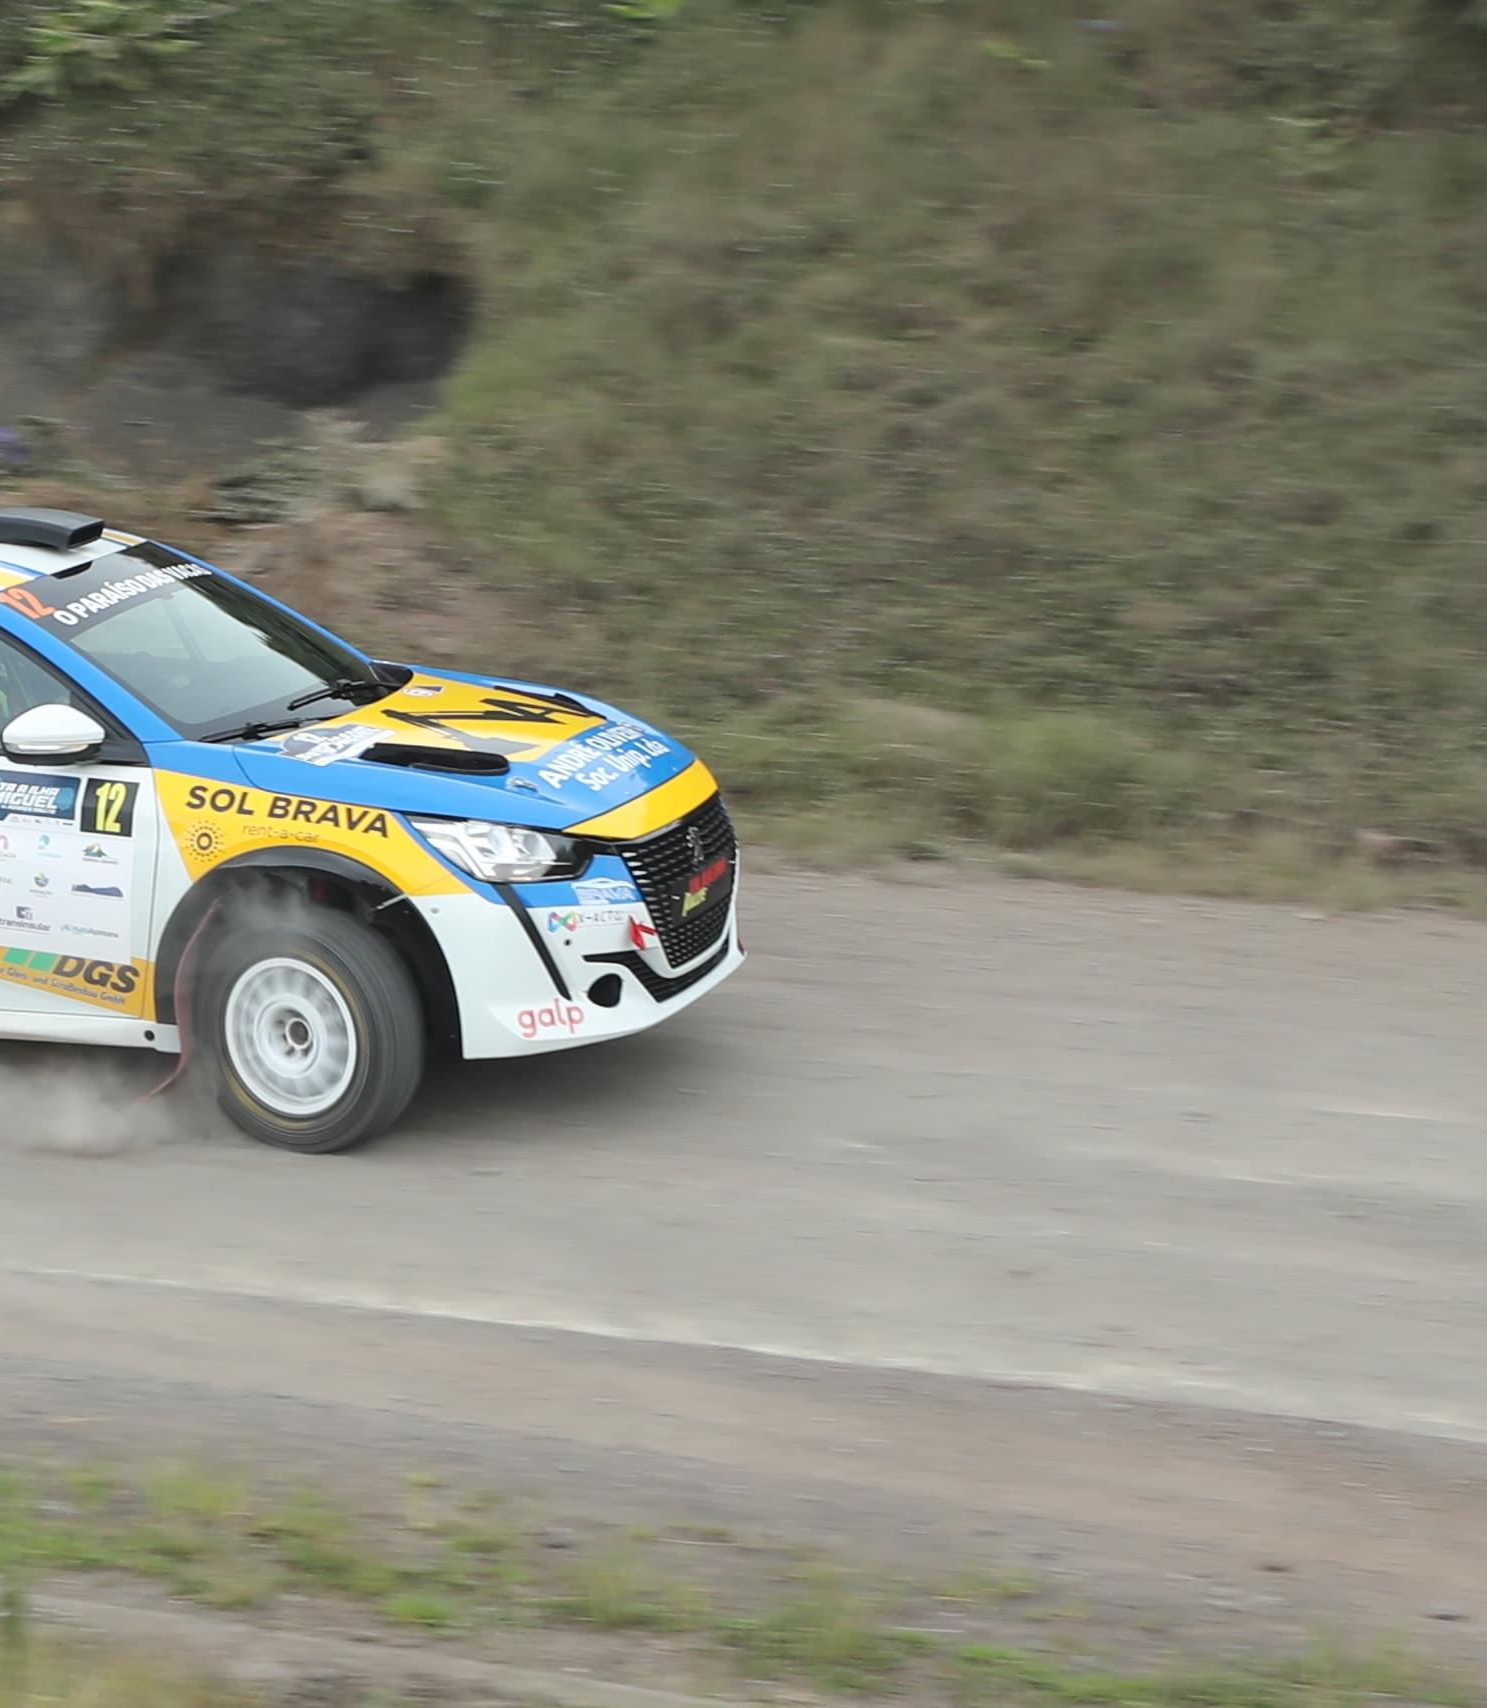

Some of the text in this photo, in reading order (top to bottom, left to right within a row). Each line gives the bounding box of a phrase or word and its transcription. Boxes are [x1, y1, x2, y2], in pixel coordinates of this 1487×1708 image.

[53, 608, 79, 626] O
[67, 574, 147, 619] PARAÍSO
[145, 569, 175, 588] DAS
[575, 767, 619, 791] Soc.
[95, 782, 127, 832] 12
[186, 785, 389, 838] SOL BRAVA
[242, 823, 321, 843] rent-a-car
[53, 954, 141, 994] DGS
[517, 998, 584, 1038] galp
